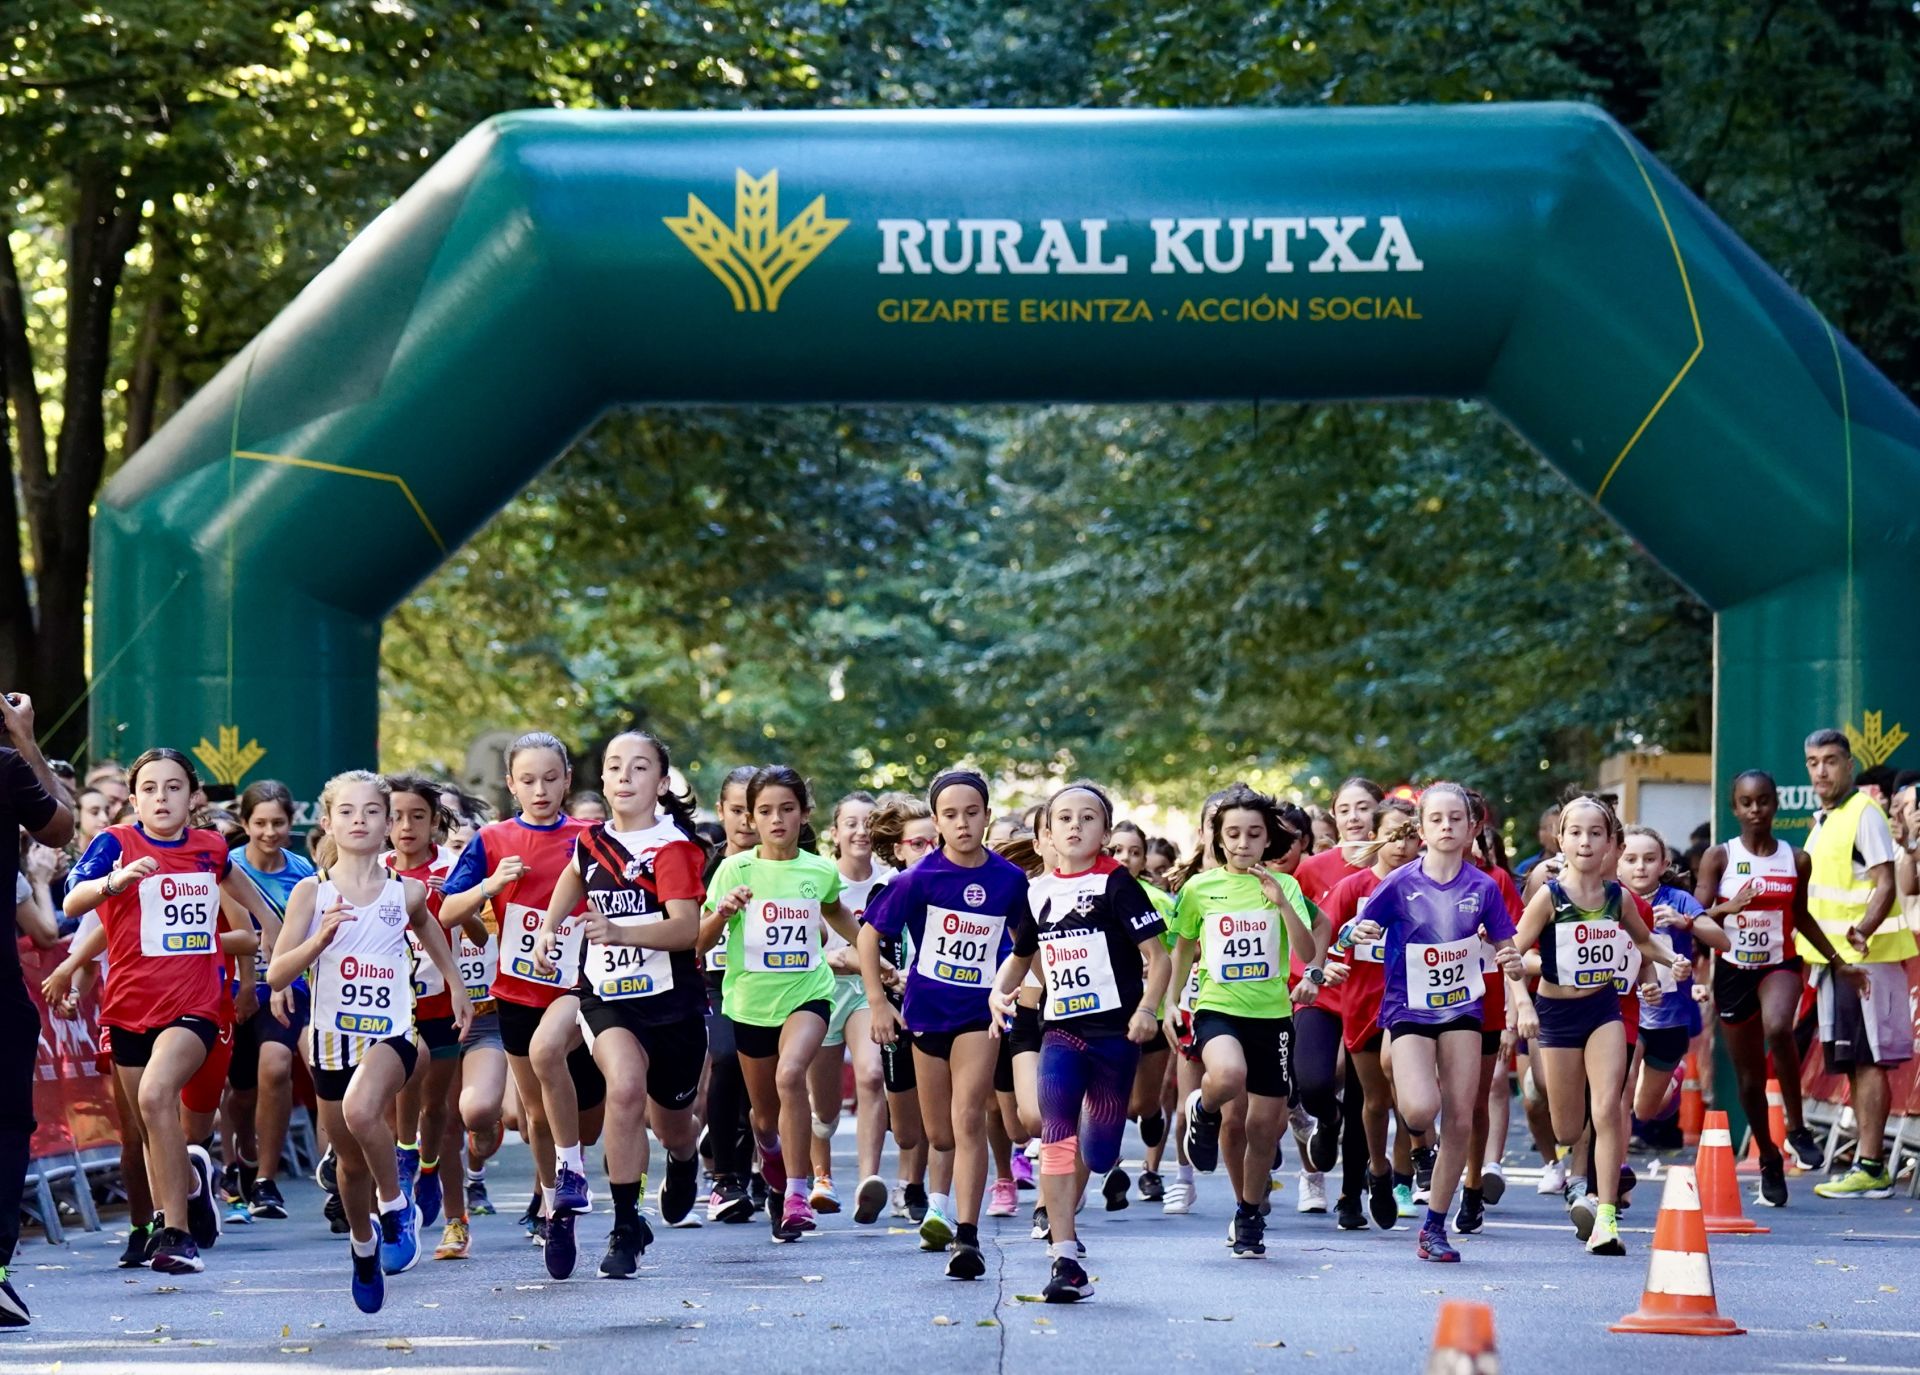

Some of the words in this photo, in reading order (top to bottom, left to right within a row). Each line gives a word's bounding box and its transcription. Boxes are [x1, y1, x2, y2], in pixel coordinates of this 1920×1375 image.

[877, 218, 1128, 275] RURAL
[1150, 216, 1424, 274] KUTXA
[877, 298, 1011, 323] GIZARTE
[1020, 299, 1154, 323] EKINTZA
[1176, 293, 1299, 322] ACCIÓN
[1308, 297, 1423, 321] SOCIAL
[162, 879, 208, 899] Bilbao
[164, 903, 207, 926] 965
[764, 903, 809, 921] Bilbao
[945, 915, 990, 936] Bilbao
[1220, 917, 1267, 936] Bilbao
[1576, 925, 1616, 943] Bilbao
[186, 935, 208, 948] BM
[766, 926, 807, 945] 974
[1738, 931, 1769, 947] 590
[520, 934, 564, 961] 95
[936, 936, 988, 962] 1401
[1046, 945, 1088, 966] Bilbao
[1223, 937, 1265, 958] 491
[1578, 944, 1614, 964] 960
[604, 947, 646, 973] 344
[784, 955, 807, 966] BM
[1425, 949, 1468, 966] Bilbao
[341, 957, 394, 980] Bilbao
[460, 962, 485, 981] 69
[954, 969, 979, 982] BM
[1242, 965, 1266, 977] BM
[1428, 964, 1465, 987] 392
[1592, 970, 1614, 983] BM
[621, 977, 647, 993] BM
[1051, 966, 1090, 991] 346
[341, 984, 391, 1008] 958
[1069, 995, 1095, 1011] BM
[1447, 988, 1466, 1005] BM
[359, 1019, 388, 1032] BM
